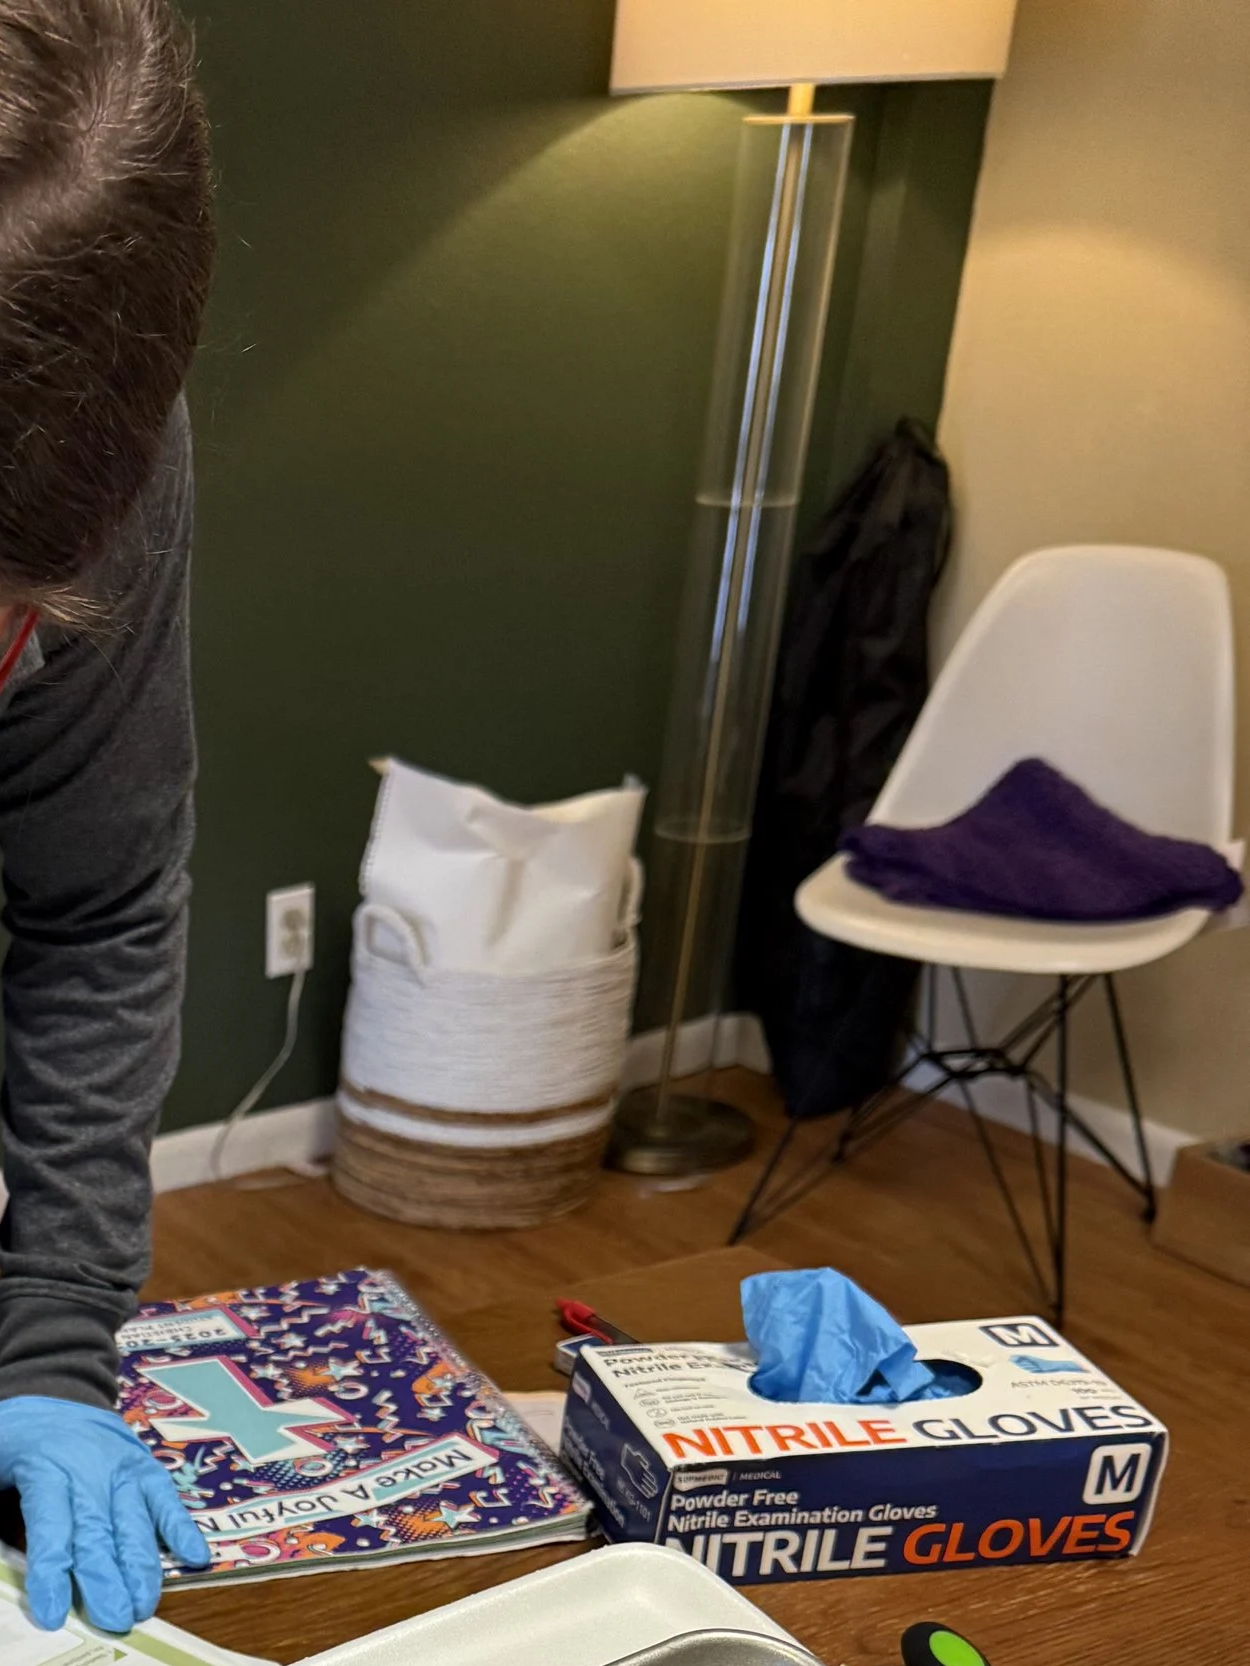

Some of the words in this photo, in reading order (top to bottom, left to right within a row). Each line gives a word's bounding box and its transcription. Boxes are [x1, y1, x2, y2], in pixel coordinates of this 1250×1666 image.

[989, 1325, 1051, 1347] M
[603, 1354, 689, 1369] Powder
[611, 1363, 682, 1379] Nitrile
[662, 1419, 906, 1459] NITRILE
[912, 1405, 1153, 1441] GLOVES
[375, 1448, 473, 1488] Make
[738, 1471, 782, 1481] MEDICAL
[1094, 1452, 1142, 1496] M
[341, 1484, 371, 1501] A
[670, 1489, 749, 1511] Powder
[752, 1489, 799, 1507] Free
[232, 1493, 339, 1530] Joyful
[667, 1511, 729, 1533] Nitrile
[734, 1506, 863, 1528] Examination
[868, 1503, 938, 1522] Gloves
[902, 1510, 1135, 1567] GLOVES
